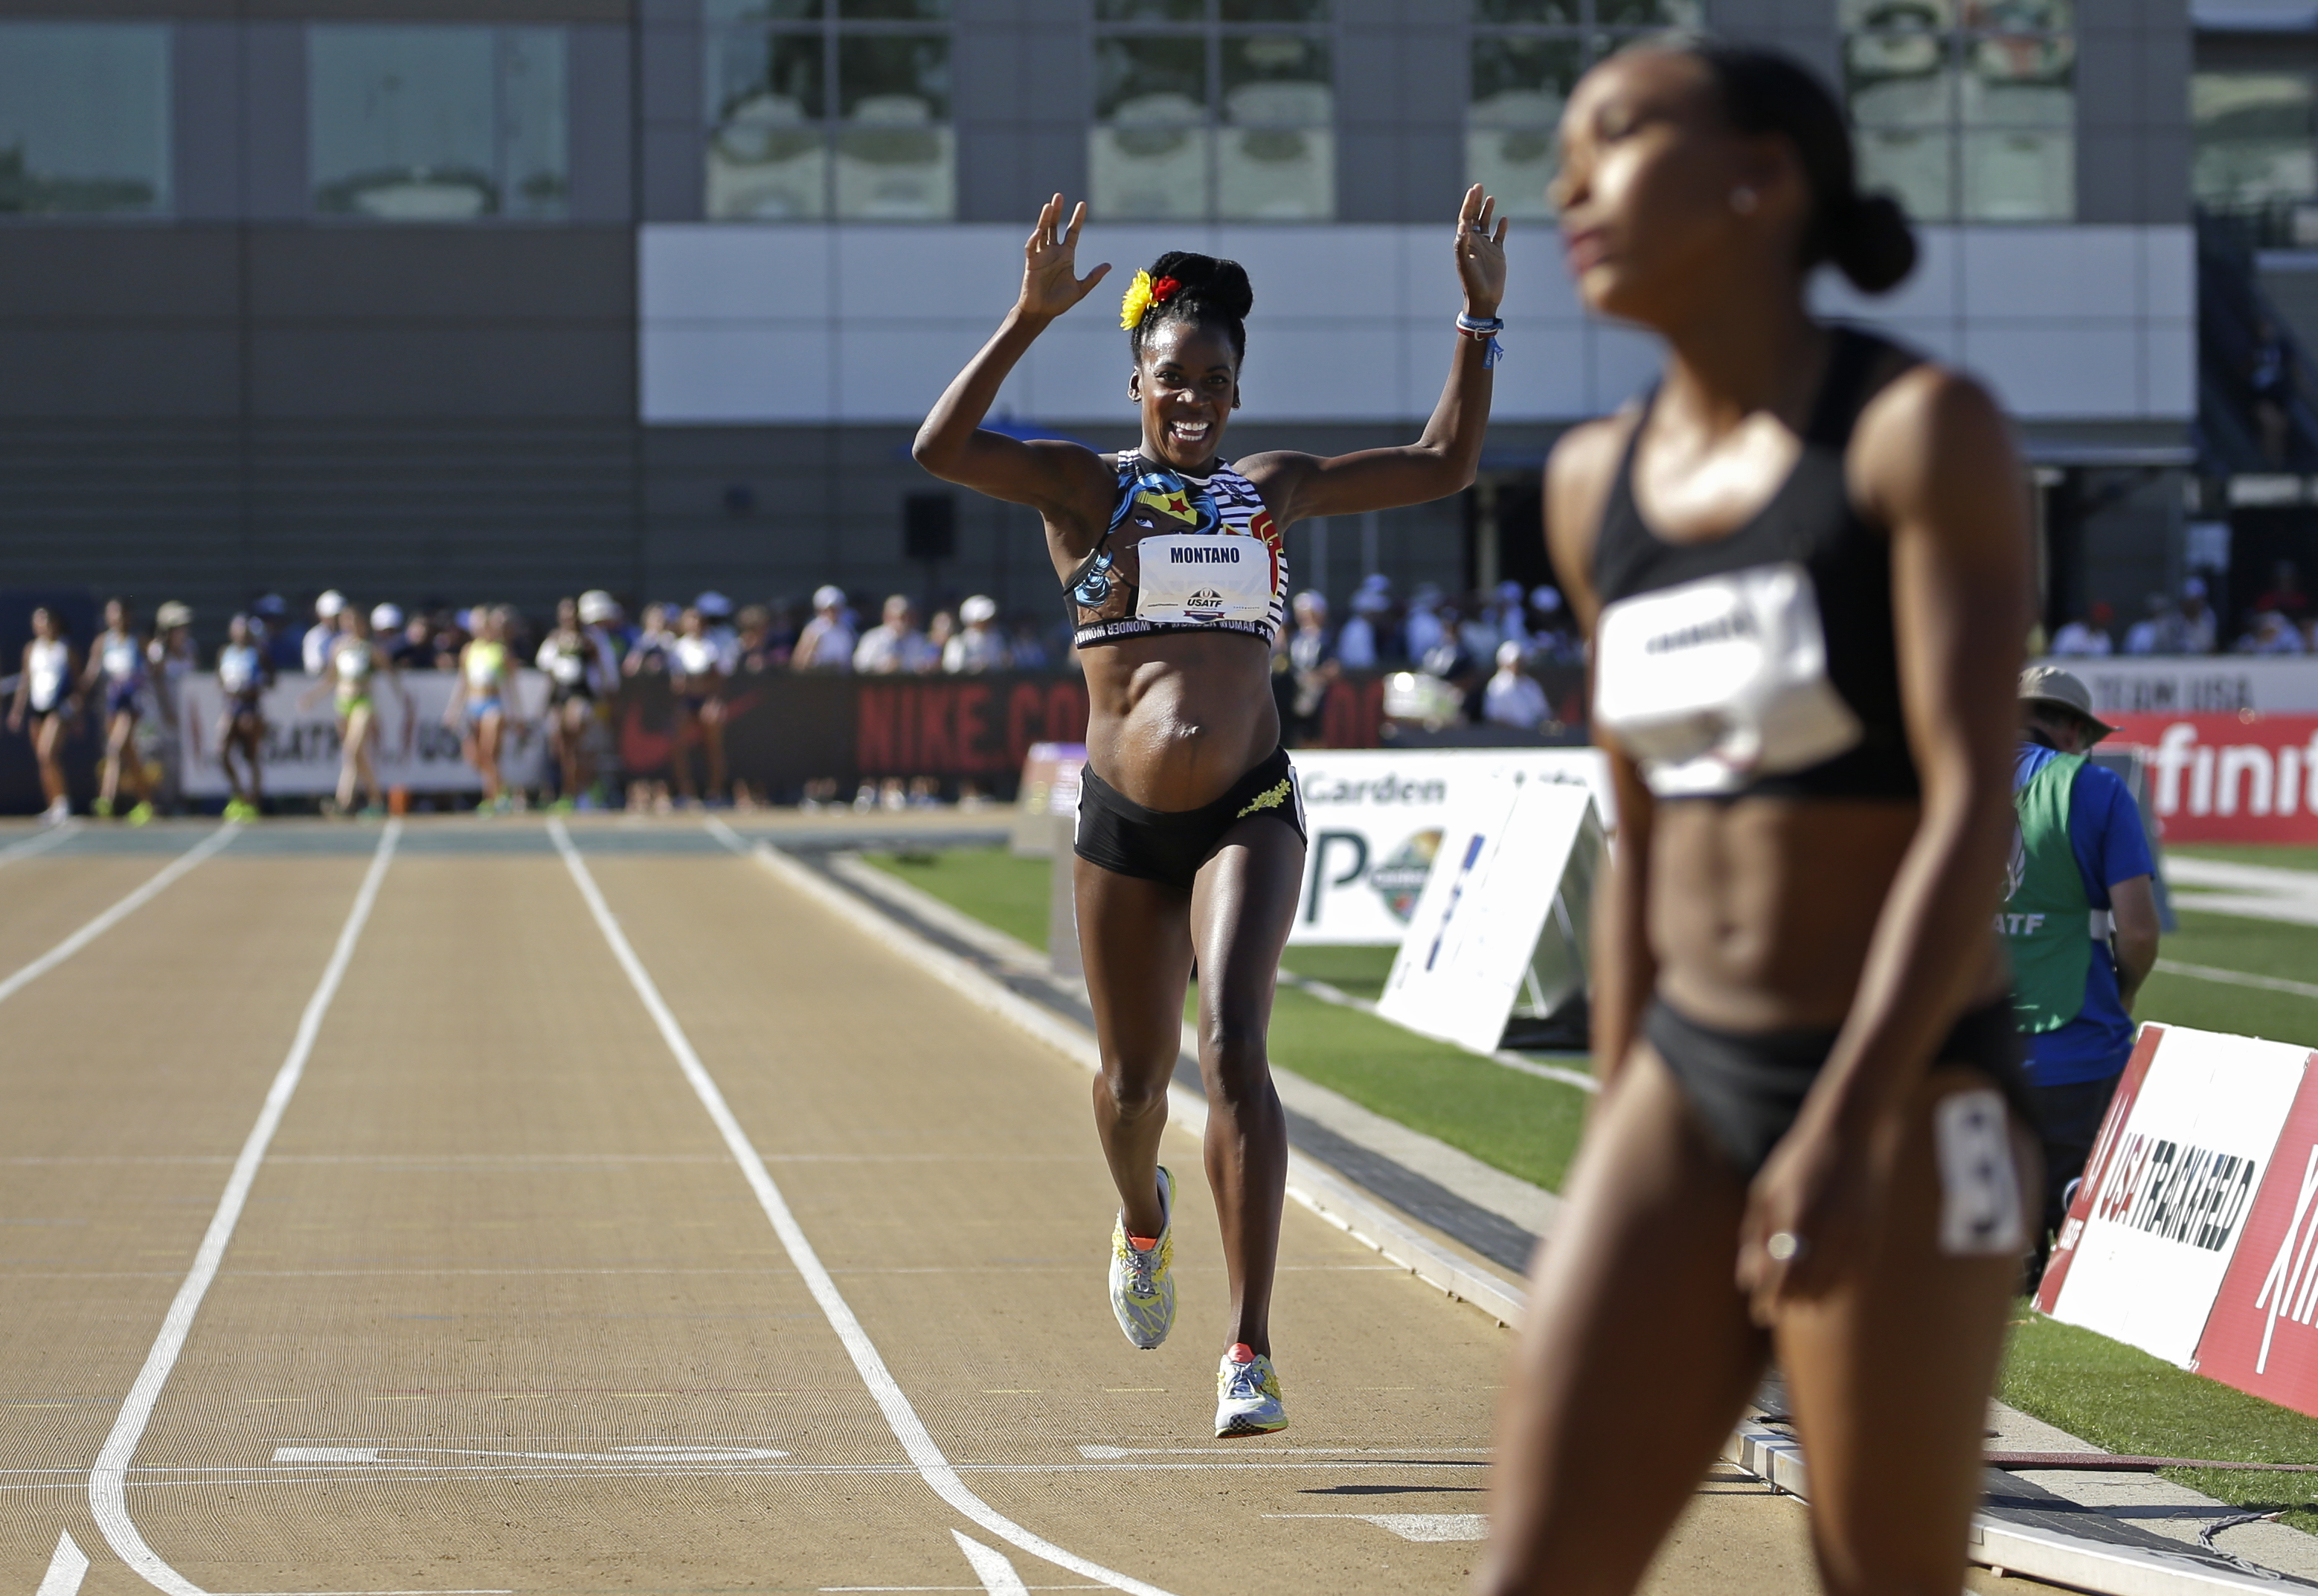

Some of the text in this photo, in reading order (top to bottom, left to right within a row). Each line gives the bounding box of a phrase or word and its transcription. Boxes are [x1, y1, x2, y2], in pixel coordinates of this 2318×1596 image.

[1170, 547, 1240, 564] MONTANO
[1187, 598, 1224, 608] USATF
[1107, 620, 1151, 635] WONDER
[1302, 770, 1448, 806] Garden
